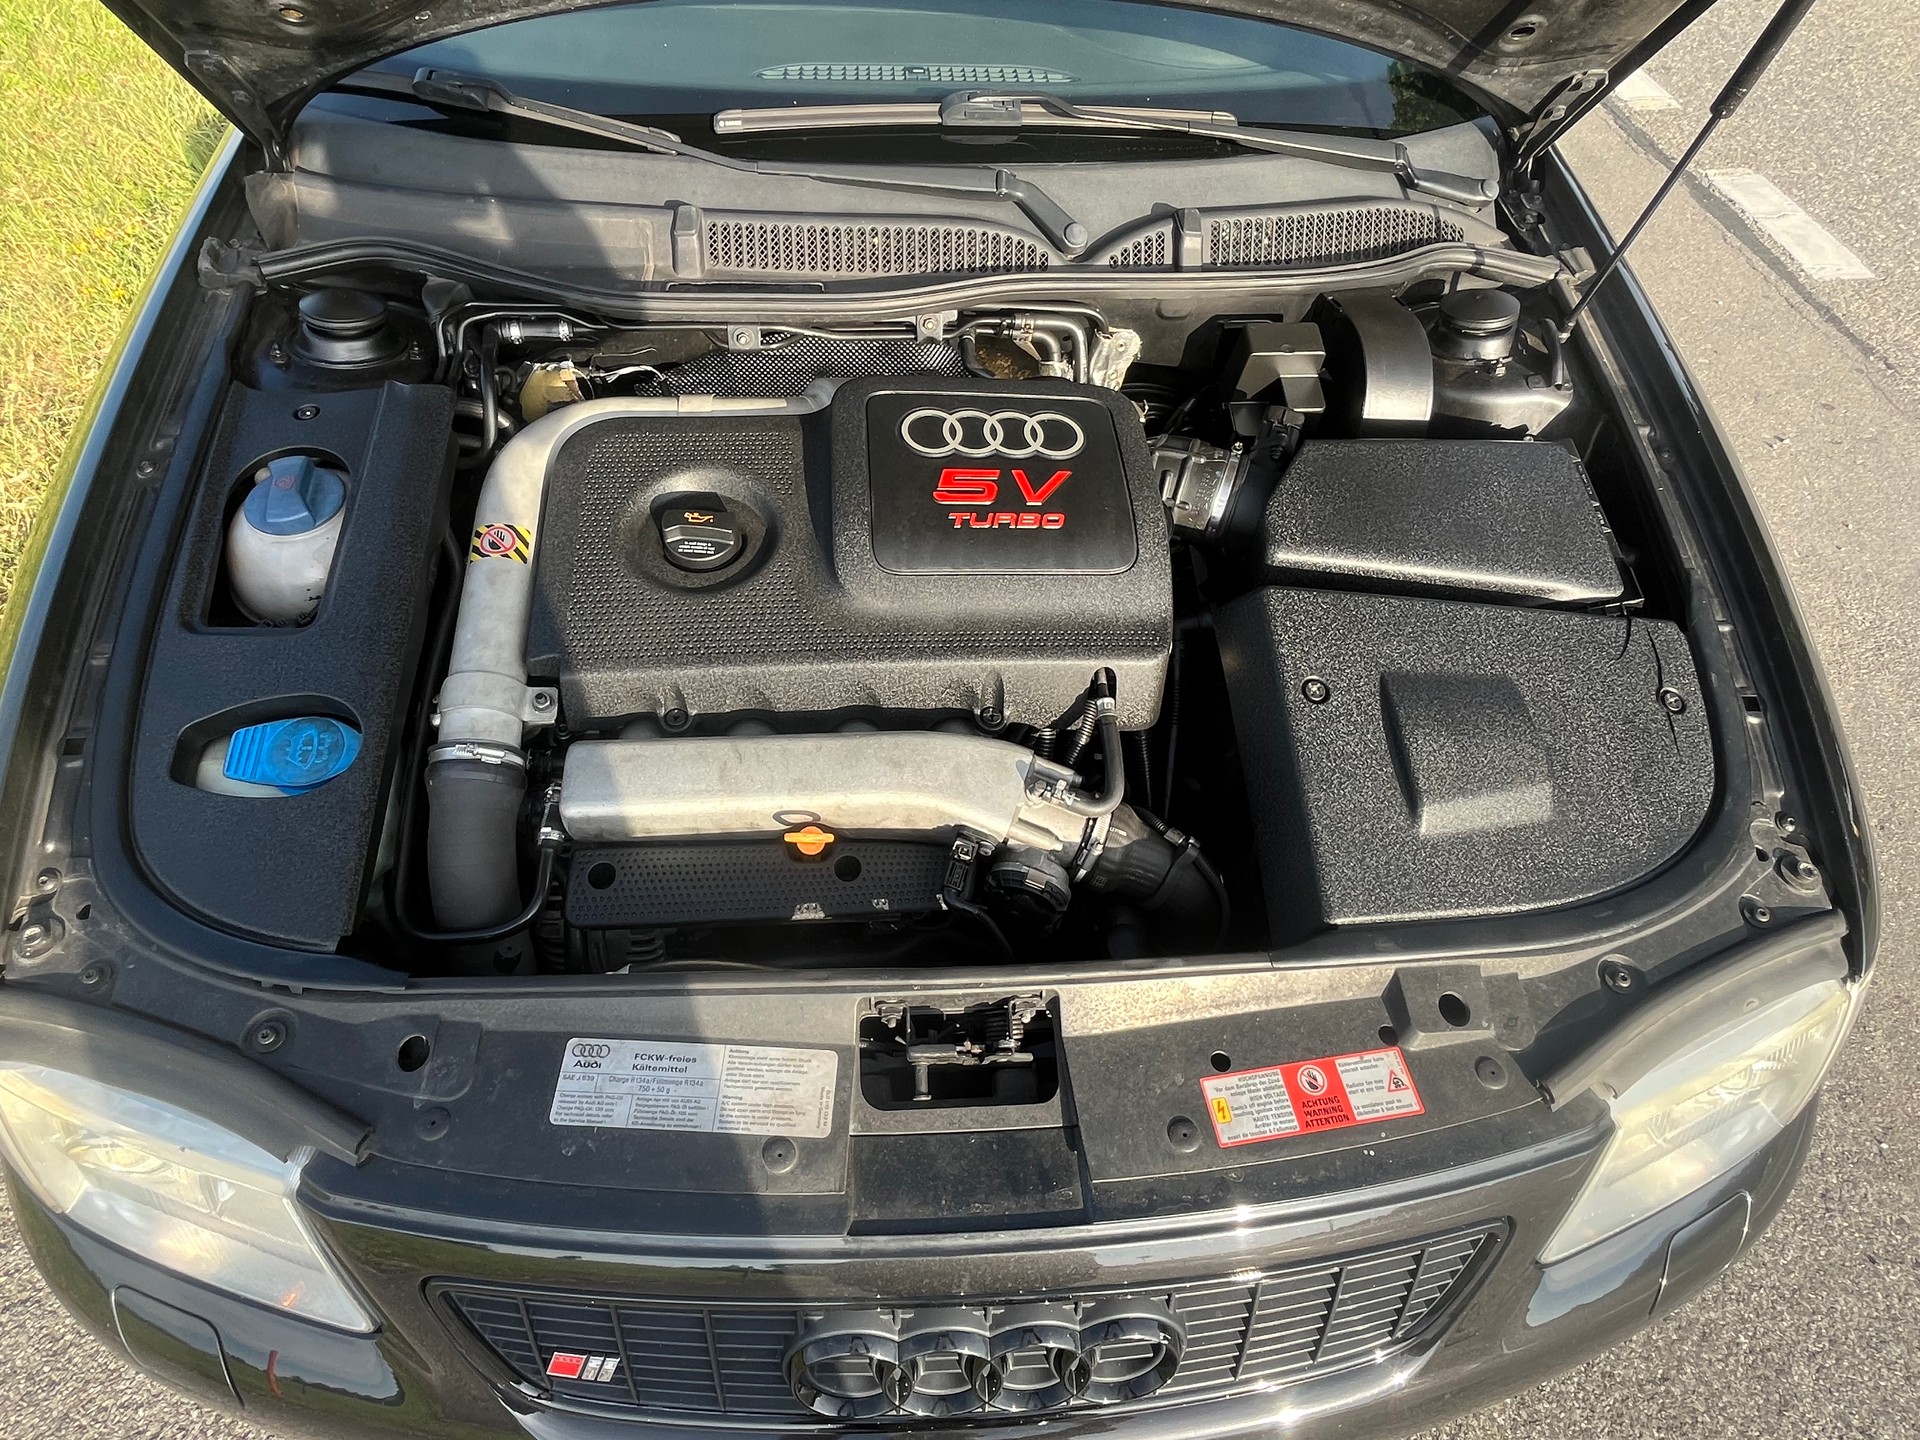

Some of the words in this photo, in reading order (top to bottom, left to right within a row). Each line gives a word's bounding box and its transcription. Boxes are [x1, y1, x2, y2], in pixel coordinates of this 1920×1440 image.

[948, 512, 1066, 529] TURBO
[634, 1053, 697, 1063] FCKW-freies
[632, 1064, 687, 1072] Kältemittel
[1301, 1096, 1340, 1108] ACHTUNG
[1304, 1105, 1343, 1117] WARNING
[1304, 1114, 1349, 1127] ATTENTION
